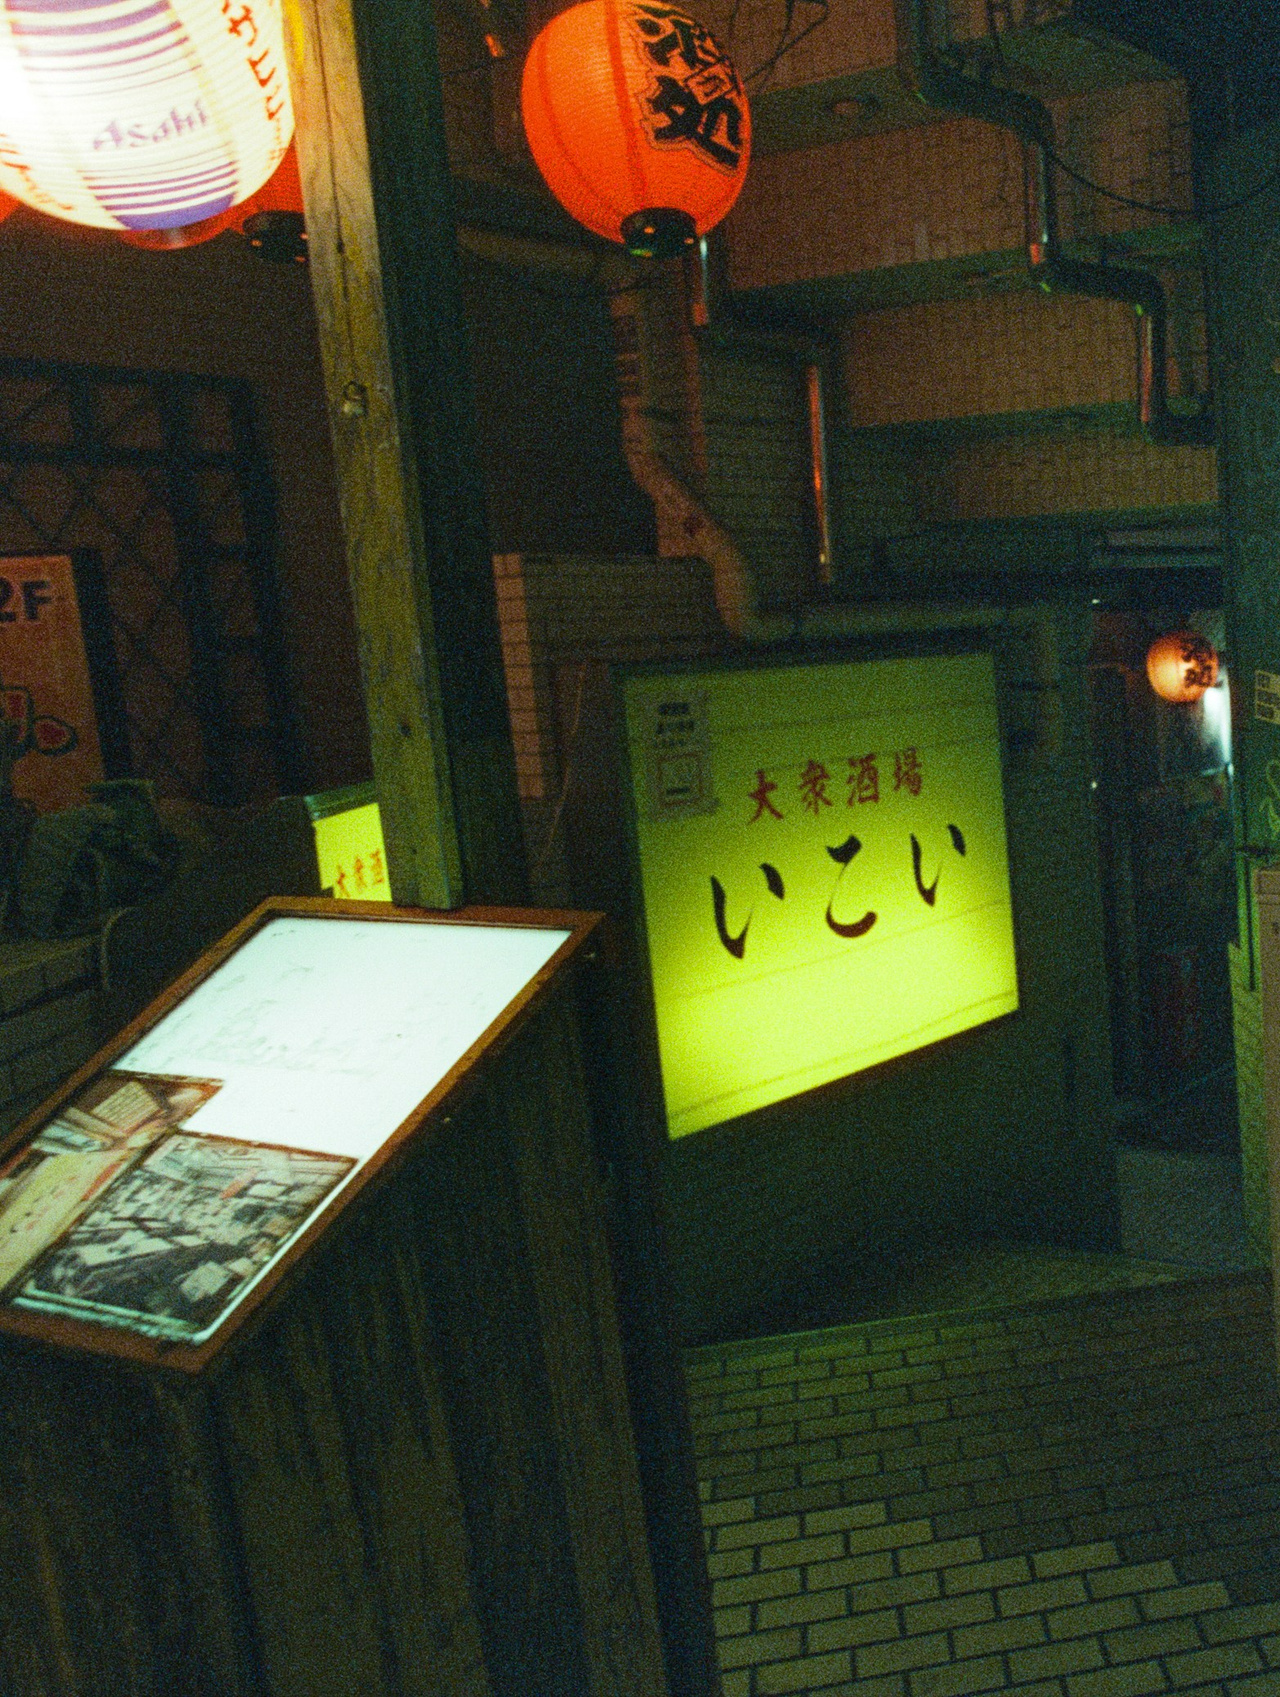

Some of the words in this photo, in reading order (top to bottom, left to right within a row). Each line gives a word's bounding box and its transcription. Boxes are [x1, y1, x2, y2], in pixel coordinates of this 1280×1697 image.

[92, 98, 207, 150] Asahi
[747, 745, 924, 826] 大衆酒場
[710, 822, 967, 960] いこい
